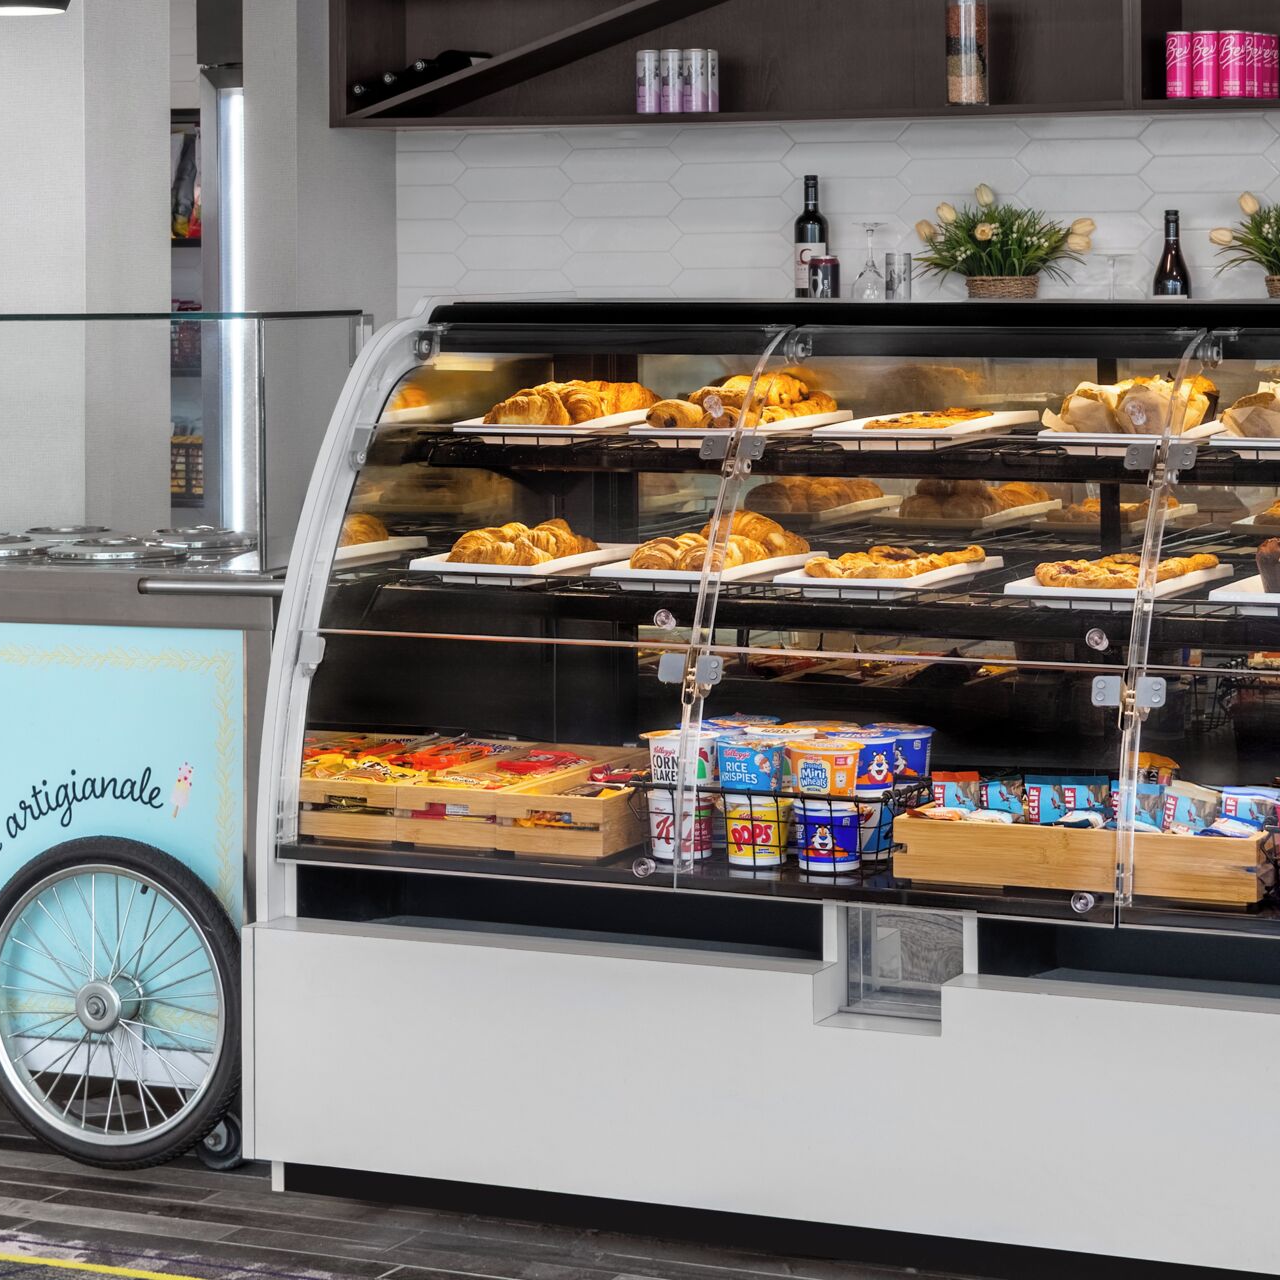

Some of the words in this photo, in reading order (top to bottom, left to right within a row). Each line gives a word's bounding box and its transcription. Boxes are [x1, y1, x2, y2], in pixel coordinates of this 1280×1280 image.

[653, 746, 676, 755] Kellogg's
[723, 748, 750, 760] Kellogg's
[652, 754, 679, 770] CORN
[725, 762, 748, 771] RICE
[721, 773, 758, 784] KRISPIES
[801, 768, 826, 778] Mini
[800, 777, 828, 788] Wheats
[6, 766, 164, 828] artigianale
[1029, 787, 1040, 814] CLIF
[1167, 796, 1178, 821] CLIF
[731, 823, 773, 853] POPS
